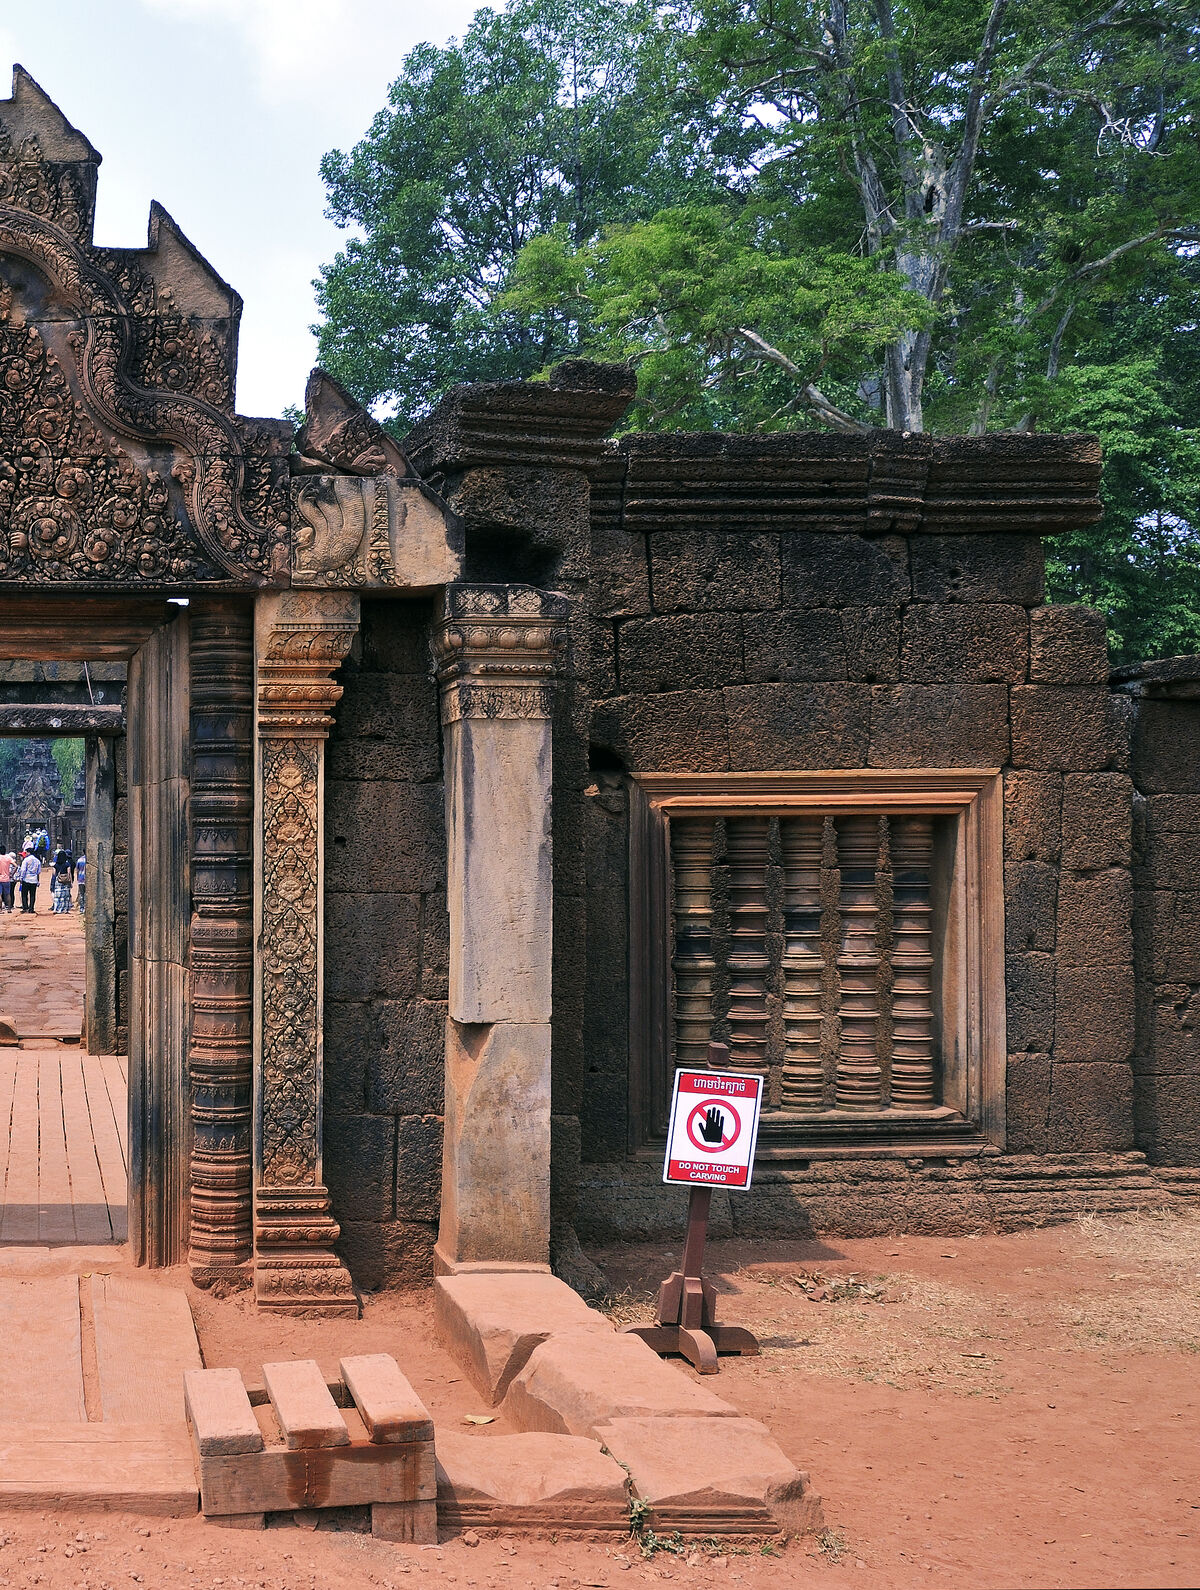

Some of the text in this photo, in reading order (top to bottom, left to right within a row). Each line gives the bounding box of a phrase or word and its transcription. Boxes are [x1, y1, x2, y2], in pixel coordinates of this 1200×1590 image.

[678, 1162, 740, 1174] DO NOT TOUCH
[689, 1172, 727, 1181] CARVING
